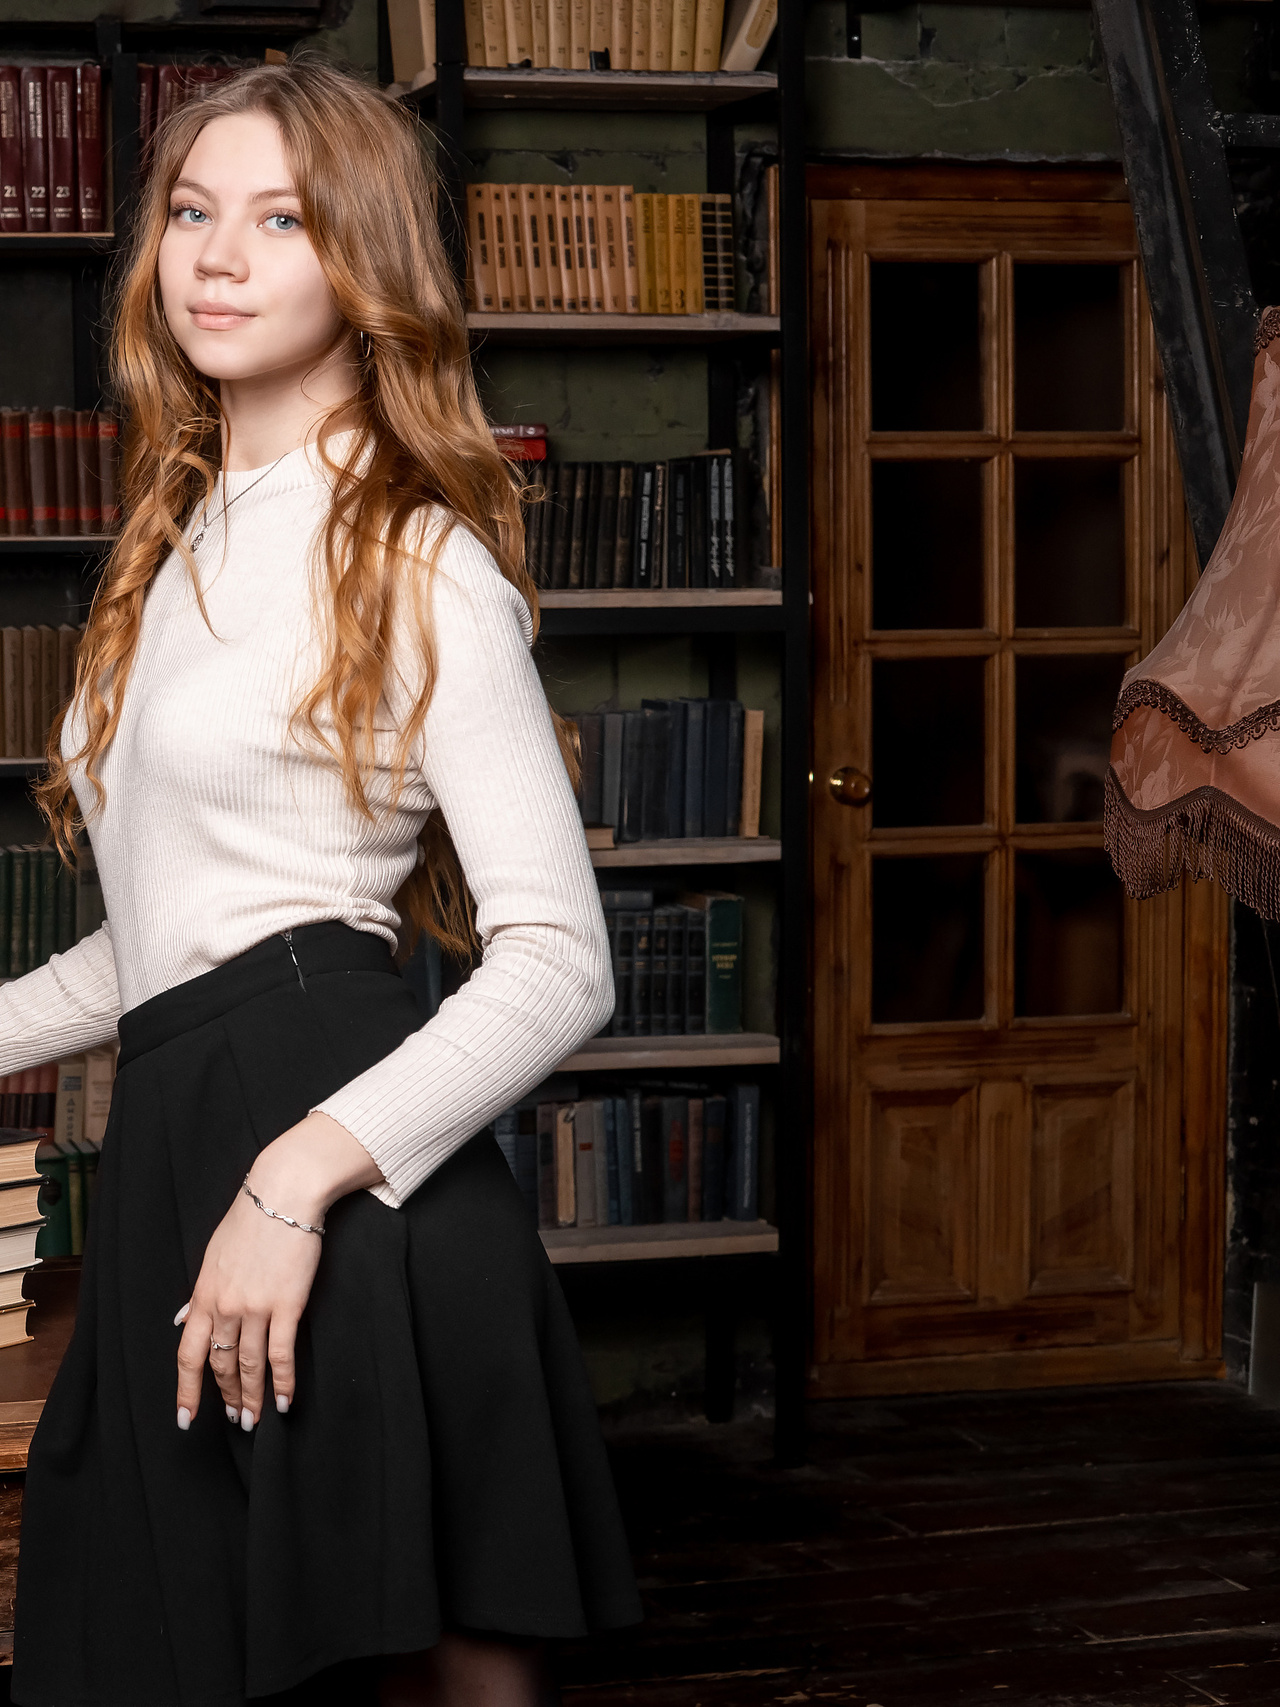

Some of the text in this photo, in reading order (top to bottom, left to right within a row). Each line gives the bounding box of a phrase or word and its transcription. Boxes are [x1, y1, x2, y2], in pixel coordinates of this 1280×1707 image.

[4, 185, 17, 198] 21
[31, 186, 46, 198] 22
[56, 186, 71, 198] 23
